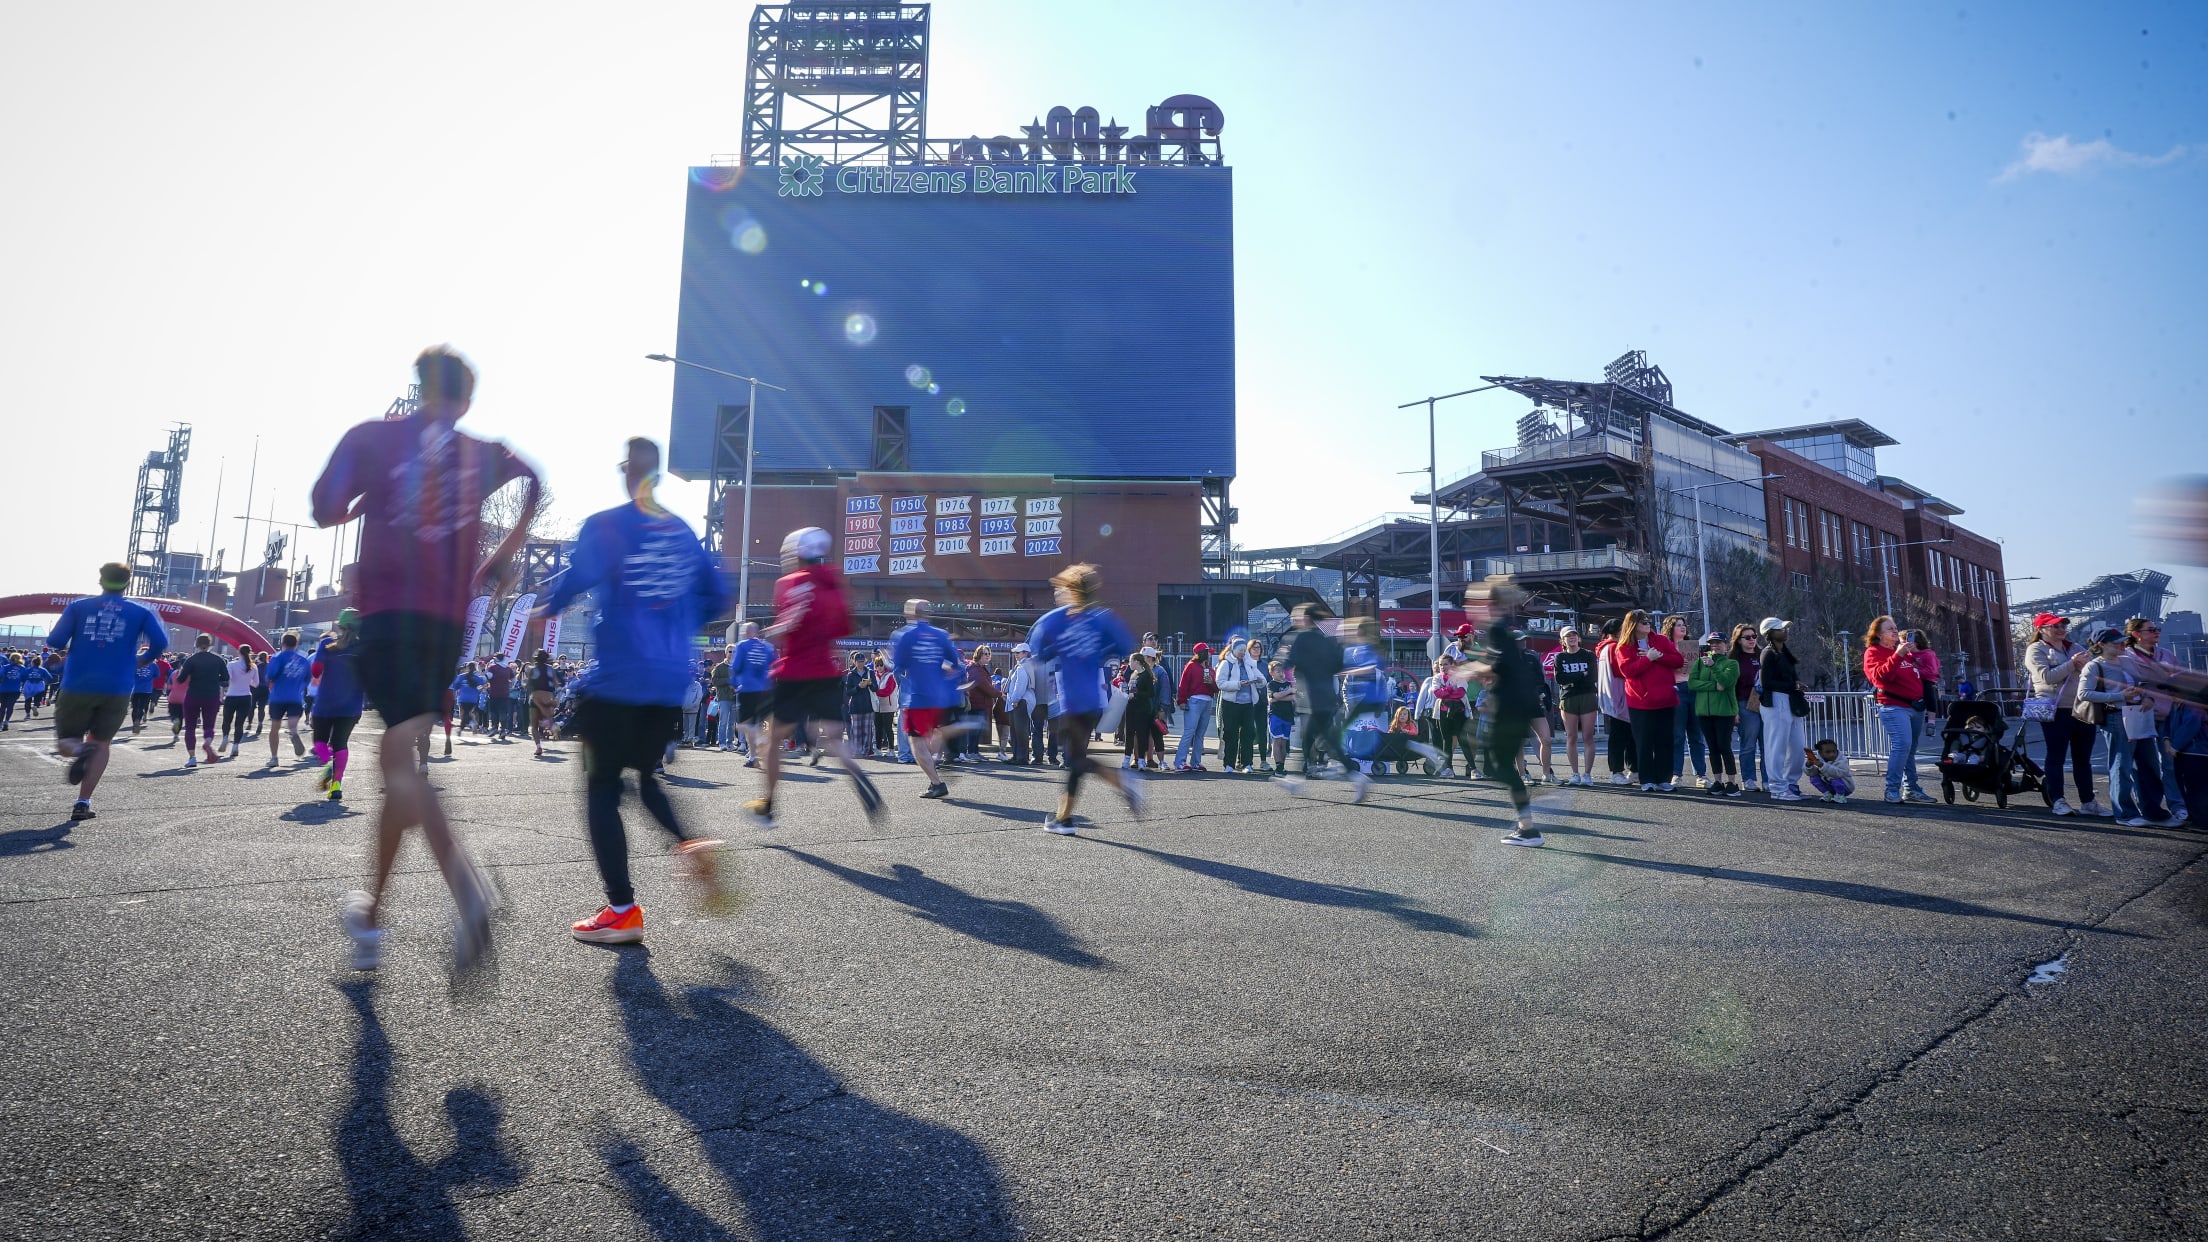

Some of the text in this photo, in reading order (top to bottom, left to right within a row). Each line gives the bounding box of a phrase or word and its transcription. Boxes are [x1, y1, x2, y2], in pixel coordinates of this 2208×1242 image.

[836, 164, 1137, 194] Citizens Bank Park
[851, 499, 876, 510] 1915
[895, 499, 921, 510] 1950
[939, 500, 965, 512] 1976
[985, 500, 1010, 512] 1977
[1030, 501, 1055, 512] 1978
[850, 518, 875, 530] 1980
[894, 519, 919, 530] 1981
[939, 519, 965, 530] 1983
[984, 520, 1009, 531] 1993
[1029, 520, 1054, 532] 2007
[848, 539, 874, 550] 2008
[893, 539, 918, 550] 2009
[939, 539, 964, 551] 2010
[984, 540, 1009, 551] 2011
[1029, 540, 1054, 552] 2022
[848, 558, 873, 569] 2023
[892, 560, 918, 571] 2024
[503, 618, 523, 658] FINISH
